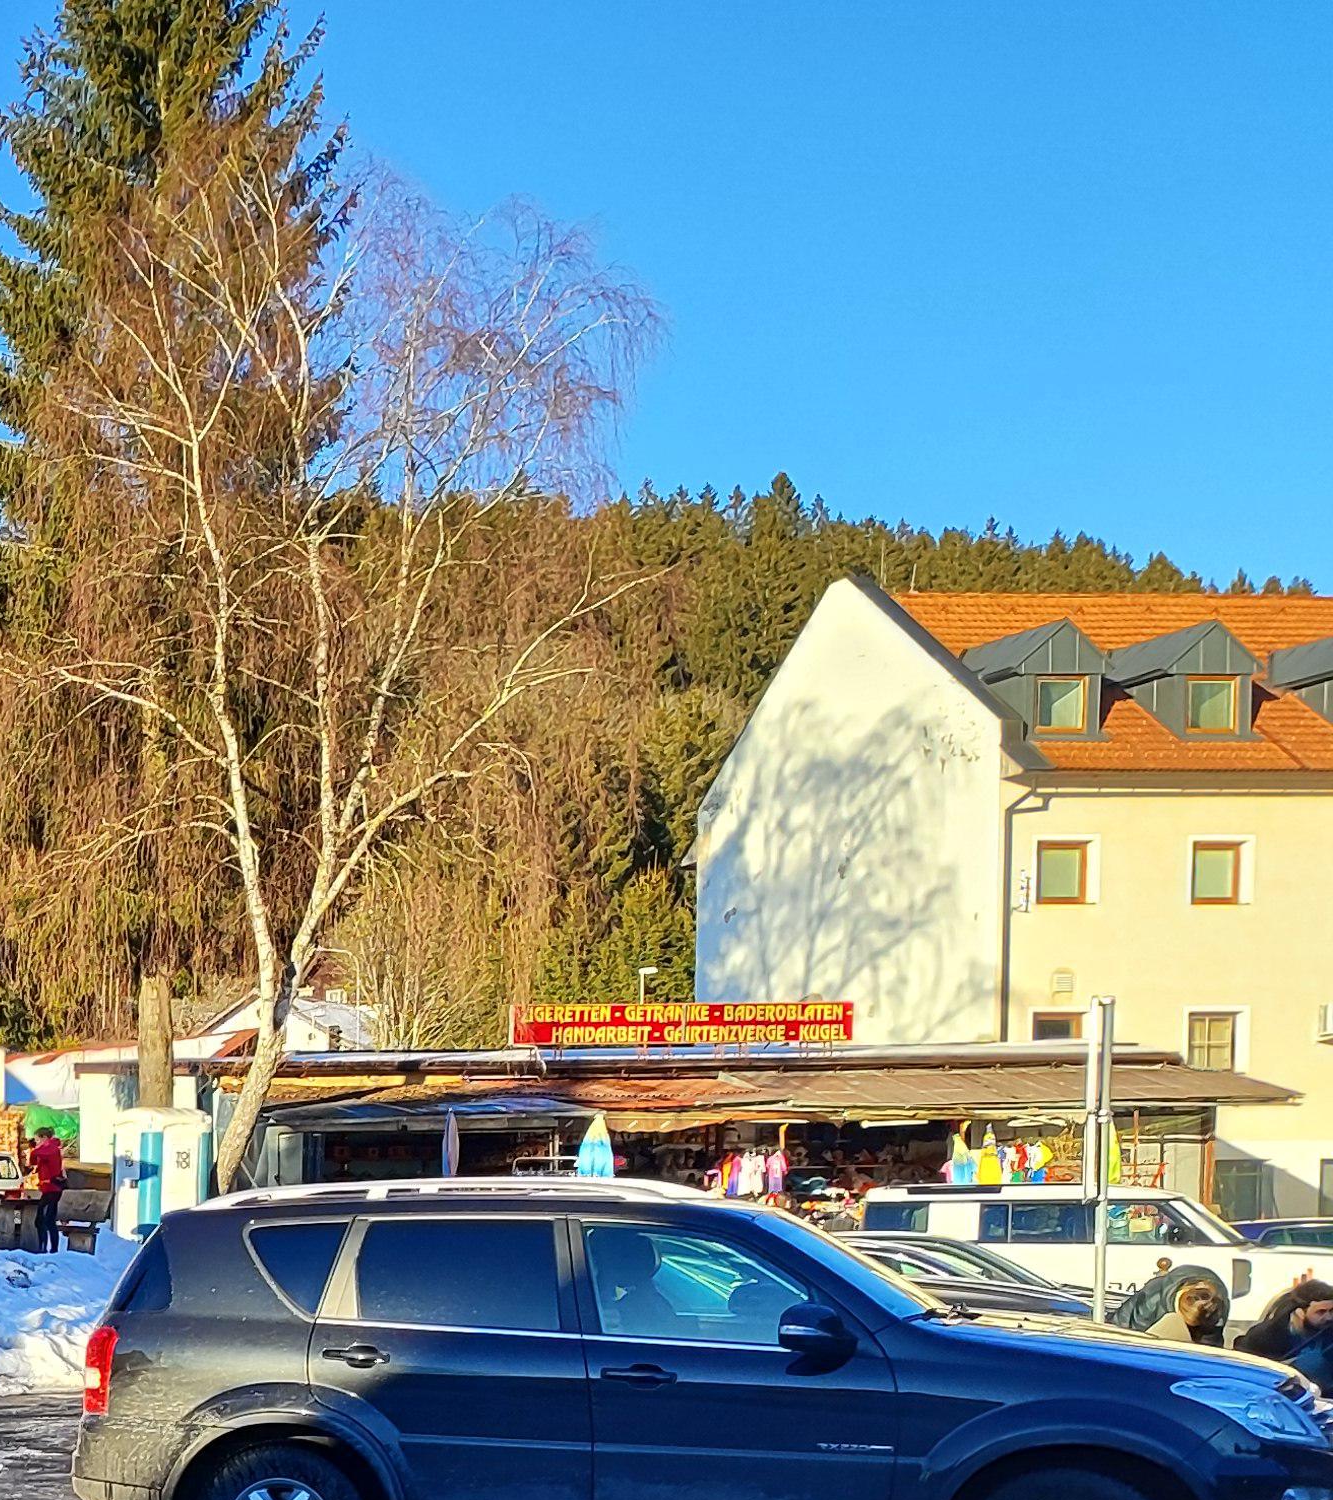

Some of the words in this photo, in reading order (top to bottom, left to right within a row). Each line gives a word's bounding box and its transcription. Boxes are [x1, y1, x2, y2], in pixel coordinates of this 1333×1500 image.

[723, 1004, 844, 1022] BADEROBLATEN
[552, 1025, 652, 1043] HANDARBEIT
[799, 1023, 848, 1041] KUGEL
